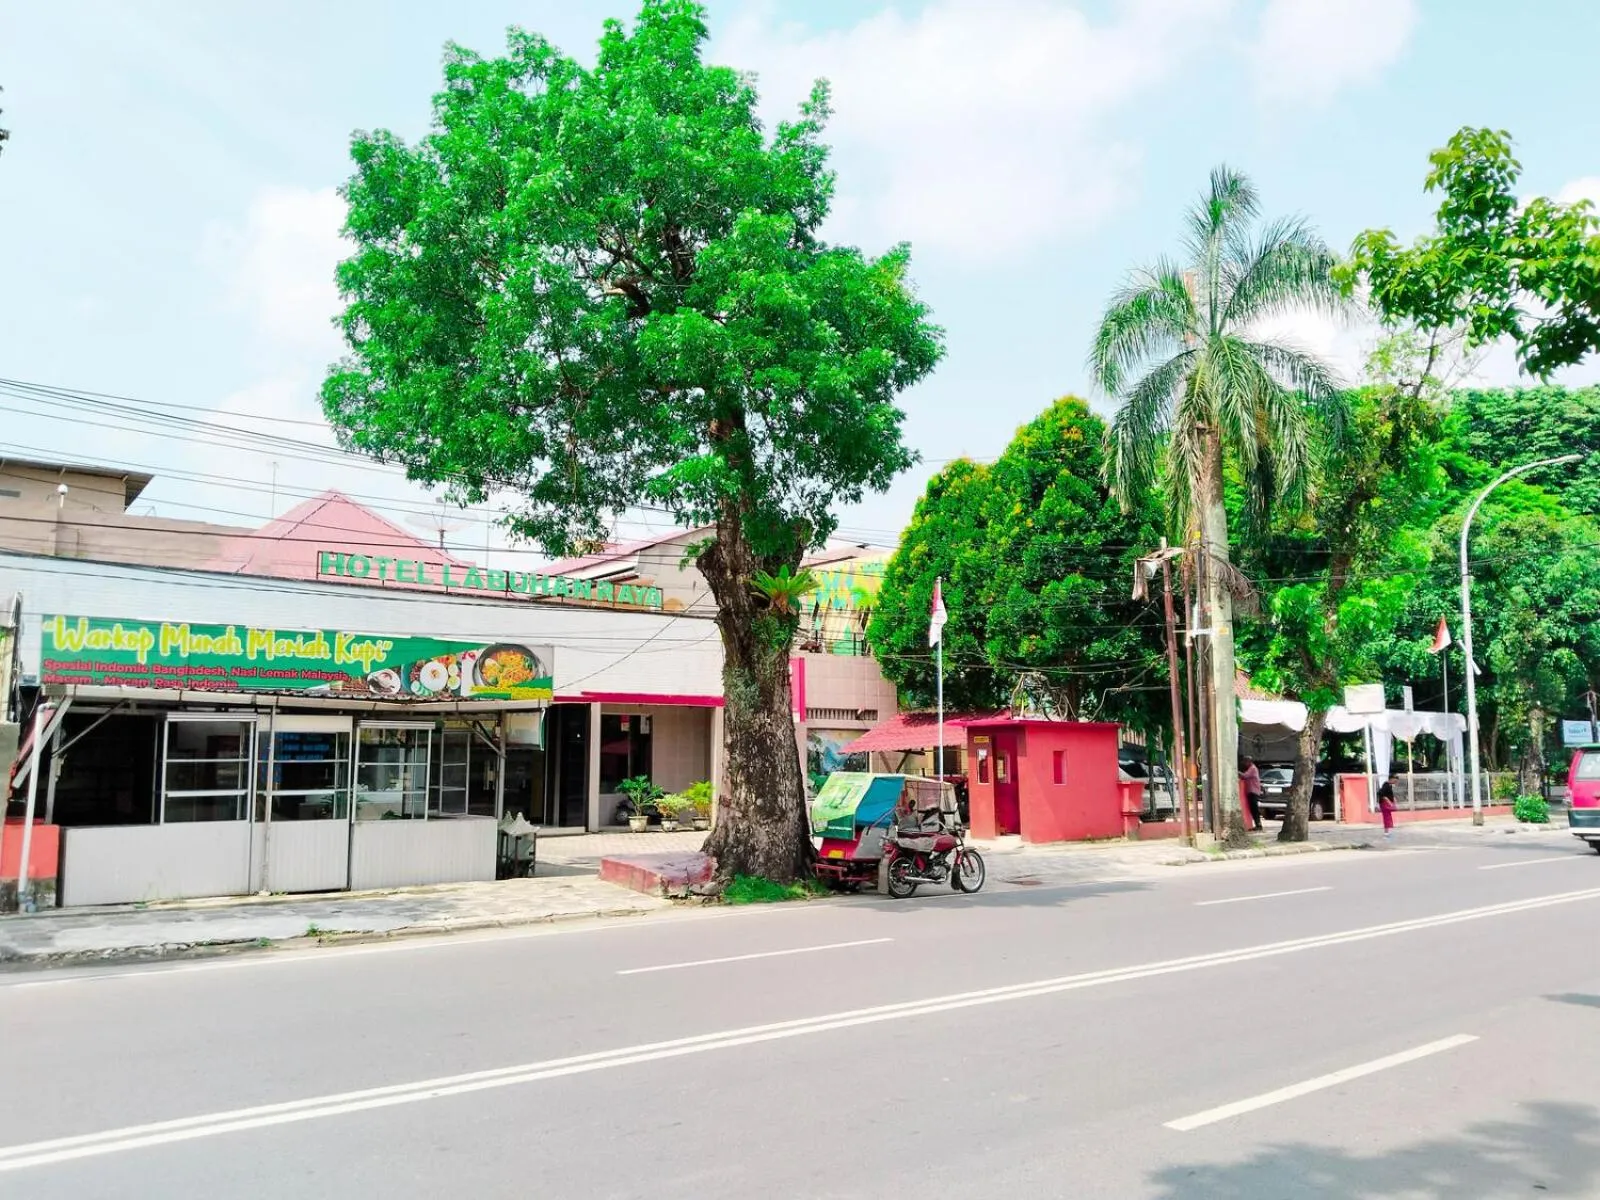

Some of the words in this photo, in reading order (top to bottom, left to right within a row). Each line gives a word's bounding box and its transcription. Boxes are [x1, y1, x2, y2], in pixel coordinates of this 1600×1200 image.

[321, 551, 434, 584] HOTEL
[160, 622, 243, 656] Murah
[247, 628, 331, 660] Meriah
[44, 659, 91, 672] Spesial
[95, 662, 149, 674] Indomie
[153, 664, 228, 677] Bangladesh,
[231, 667, 257, 676] Nasi
[260, 668, 298, 678] Lemak
[44, 673, 92, 685] Macam
